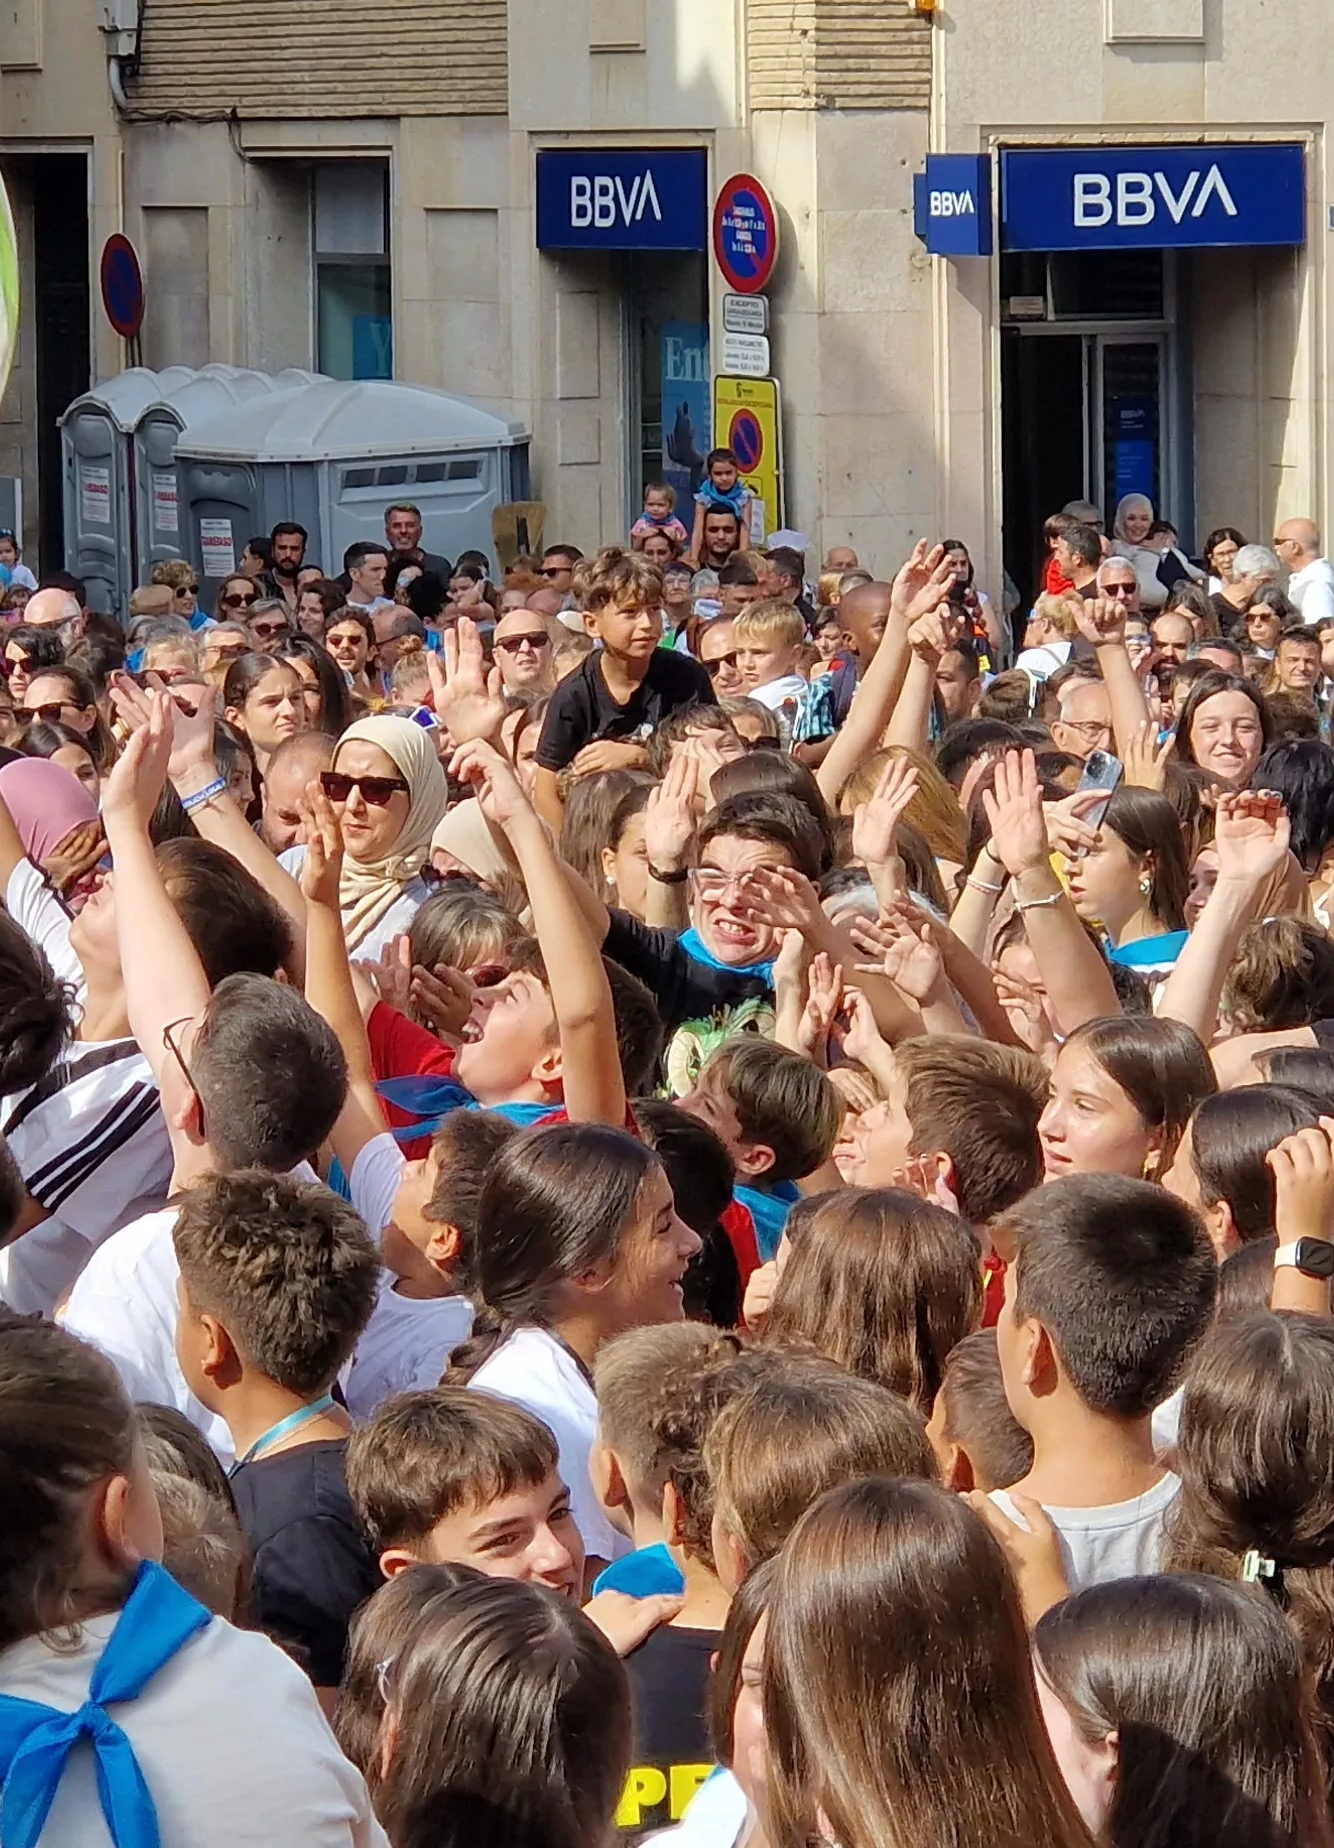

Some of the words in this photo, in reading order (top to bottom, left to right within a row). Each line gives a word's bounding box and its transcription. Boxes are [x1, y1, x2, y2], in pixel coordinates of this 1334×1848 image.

[570, 169, 662, 228] BBVA
[929, 189, 975, 217] BBVA
[1073, 164, 1238, 227] BBVA
